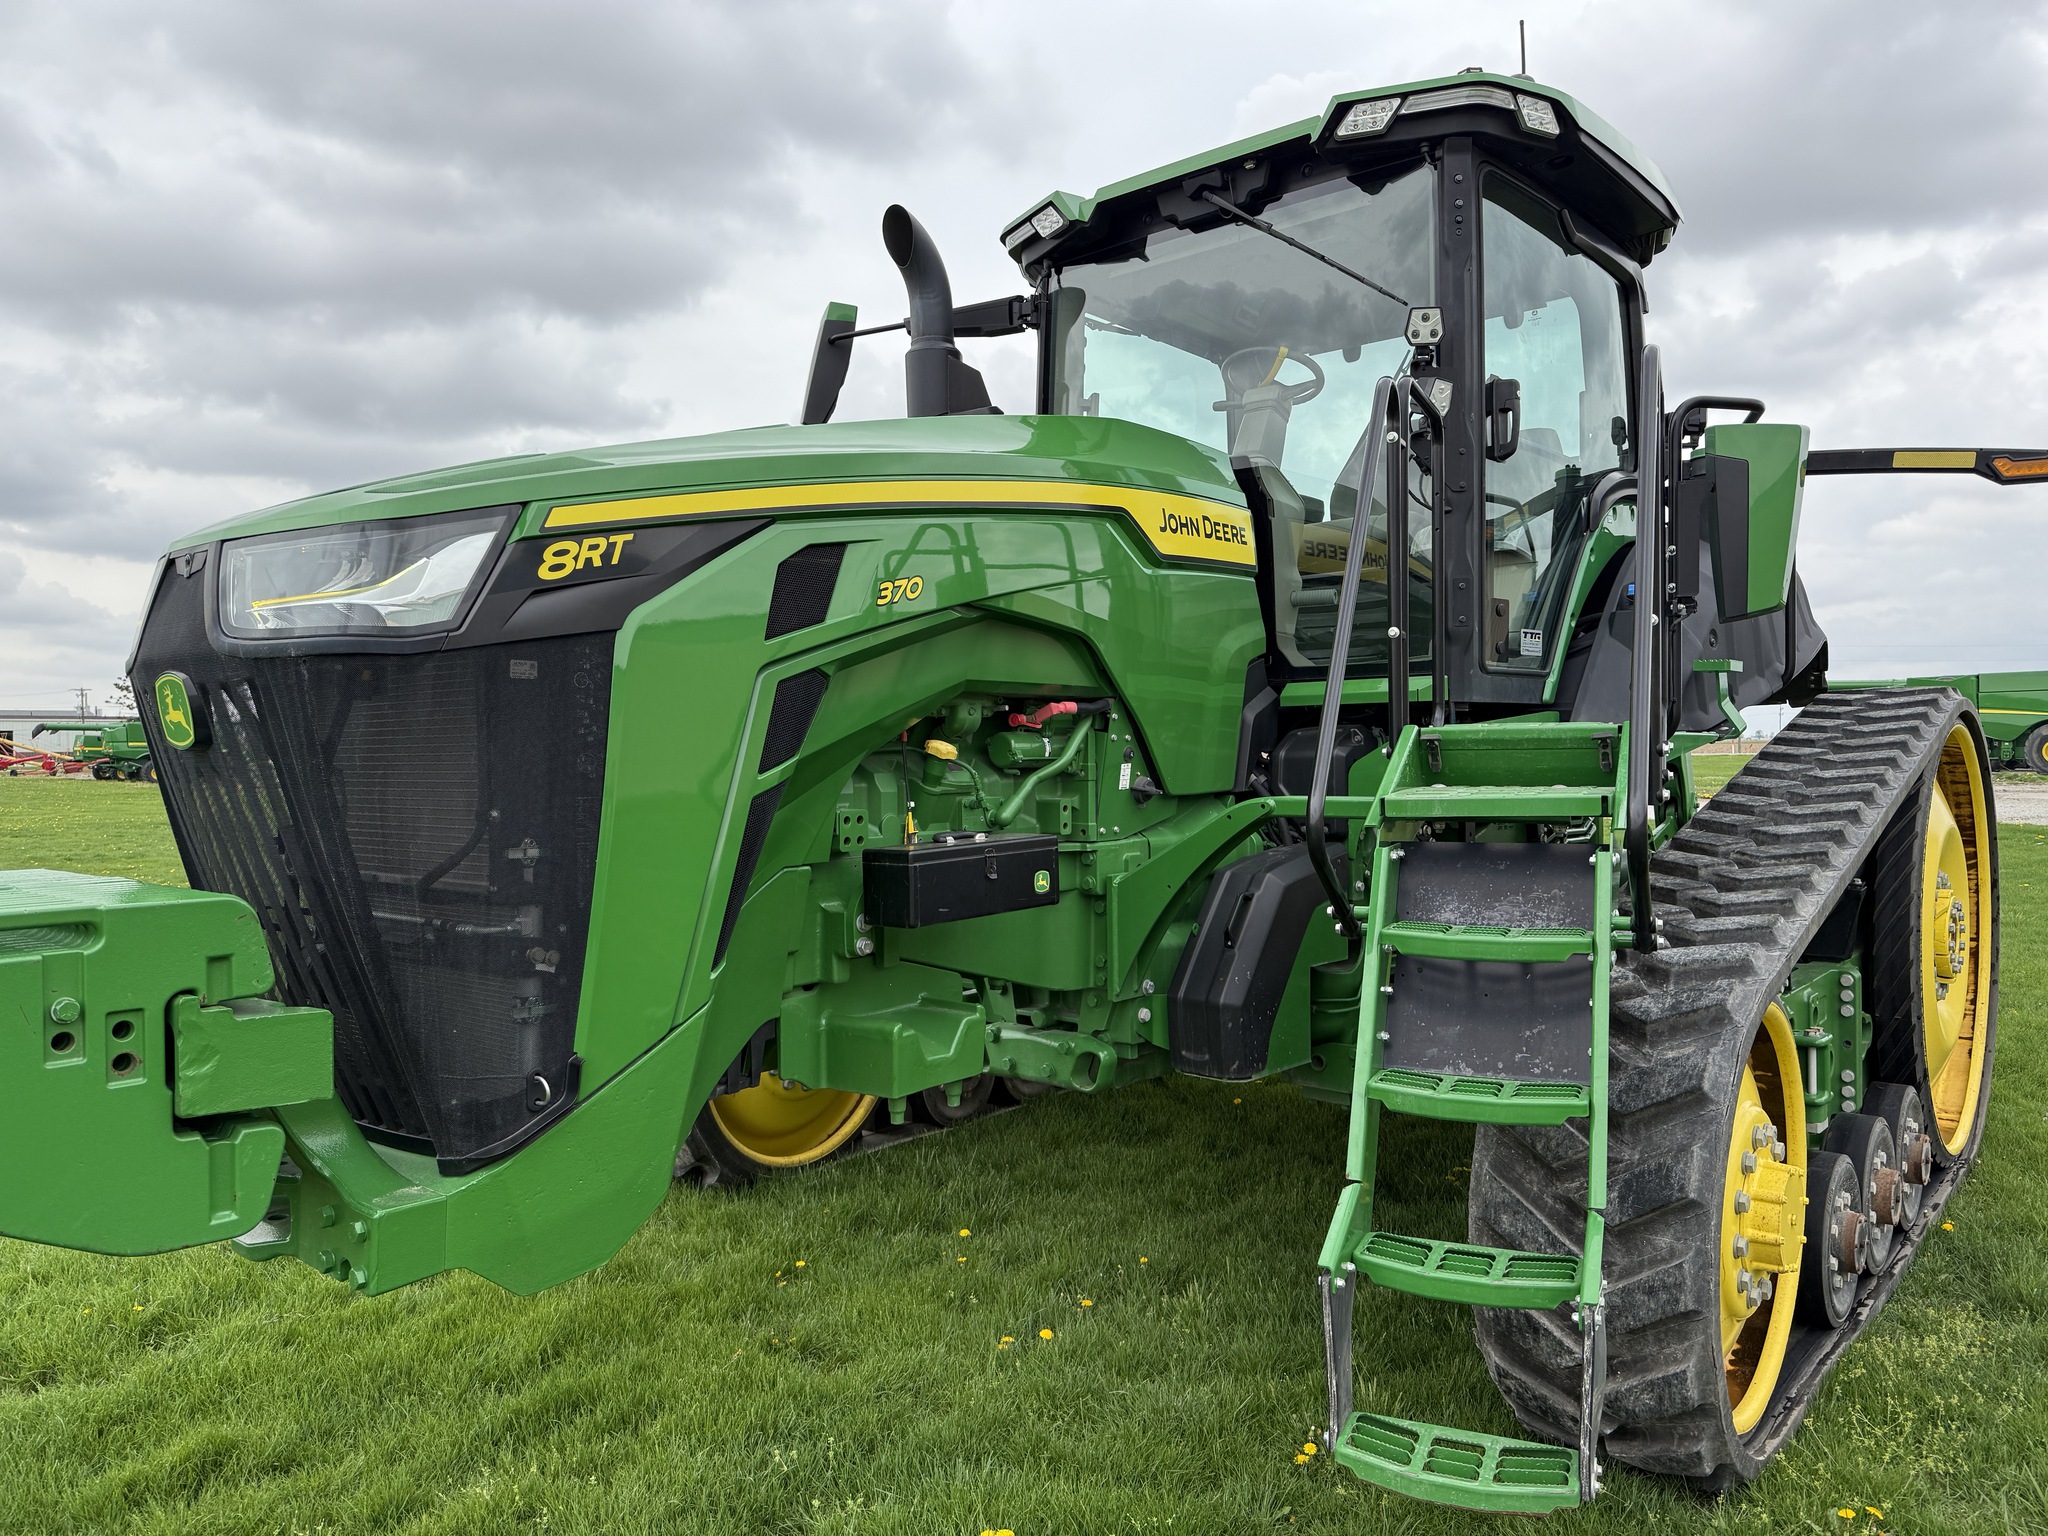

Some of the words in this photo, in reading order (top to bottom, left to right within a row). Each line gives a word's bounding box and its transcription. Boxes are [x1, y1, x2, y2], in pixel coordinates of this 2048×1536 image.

[1159, 508, 1200, 538] JOHN
[1201, 515, 1248, 546] DEERE
[537, 533, 634, 580] 8RT
[876, 575, 924, 607] 370
